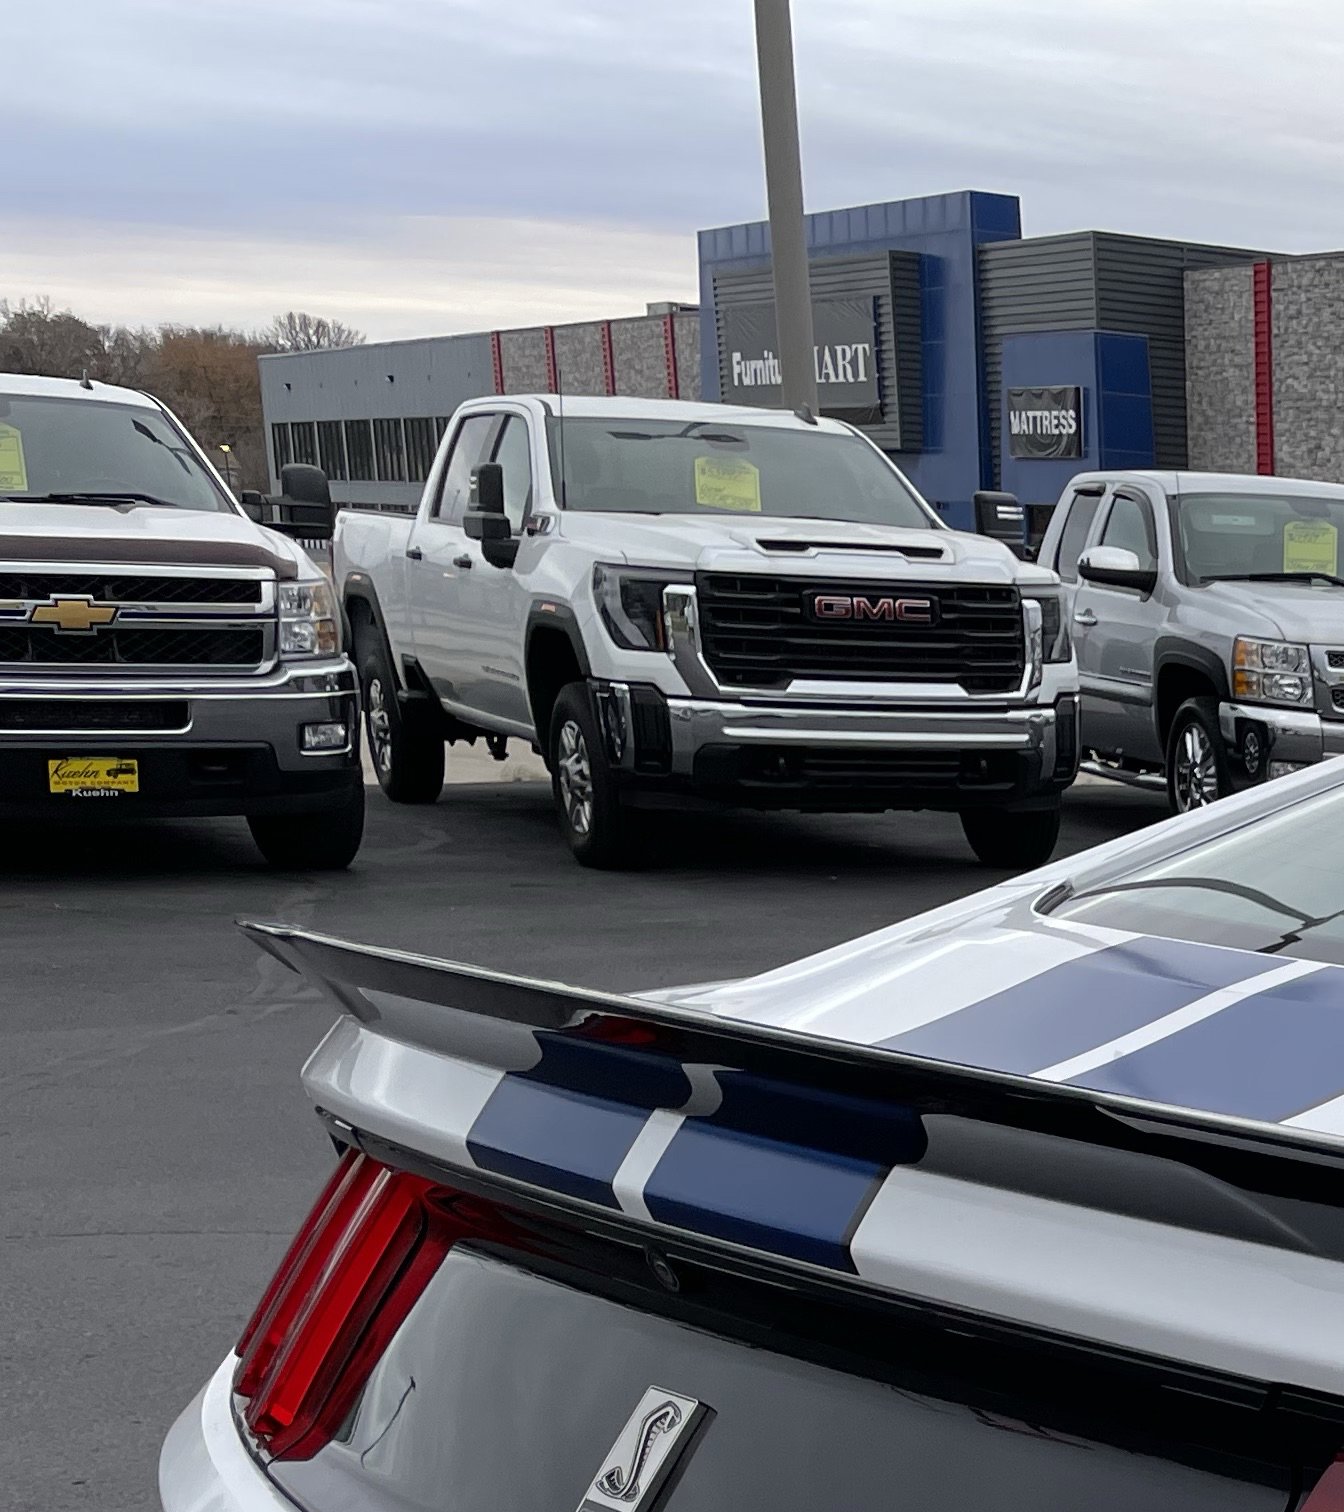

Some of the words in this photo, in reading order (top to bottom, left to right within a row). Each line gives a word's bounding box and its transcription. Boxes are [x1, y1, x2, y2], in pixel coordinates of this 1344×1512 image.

[1010, 409, 1077, 435] MATTRESS
[815, 596, 931, 621] GMC
[51, 759, 100, 781] Kuehn
[72, 788, 119, 797] Kuehn
